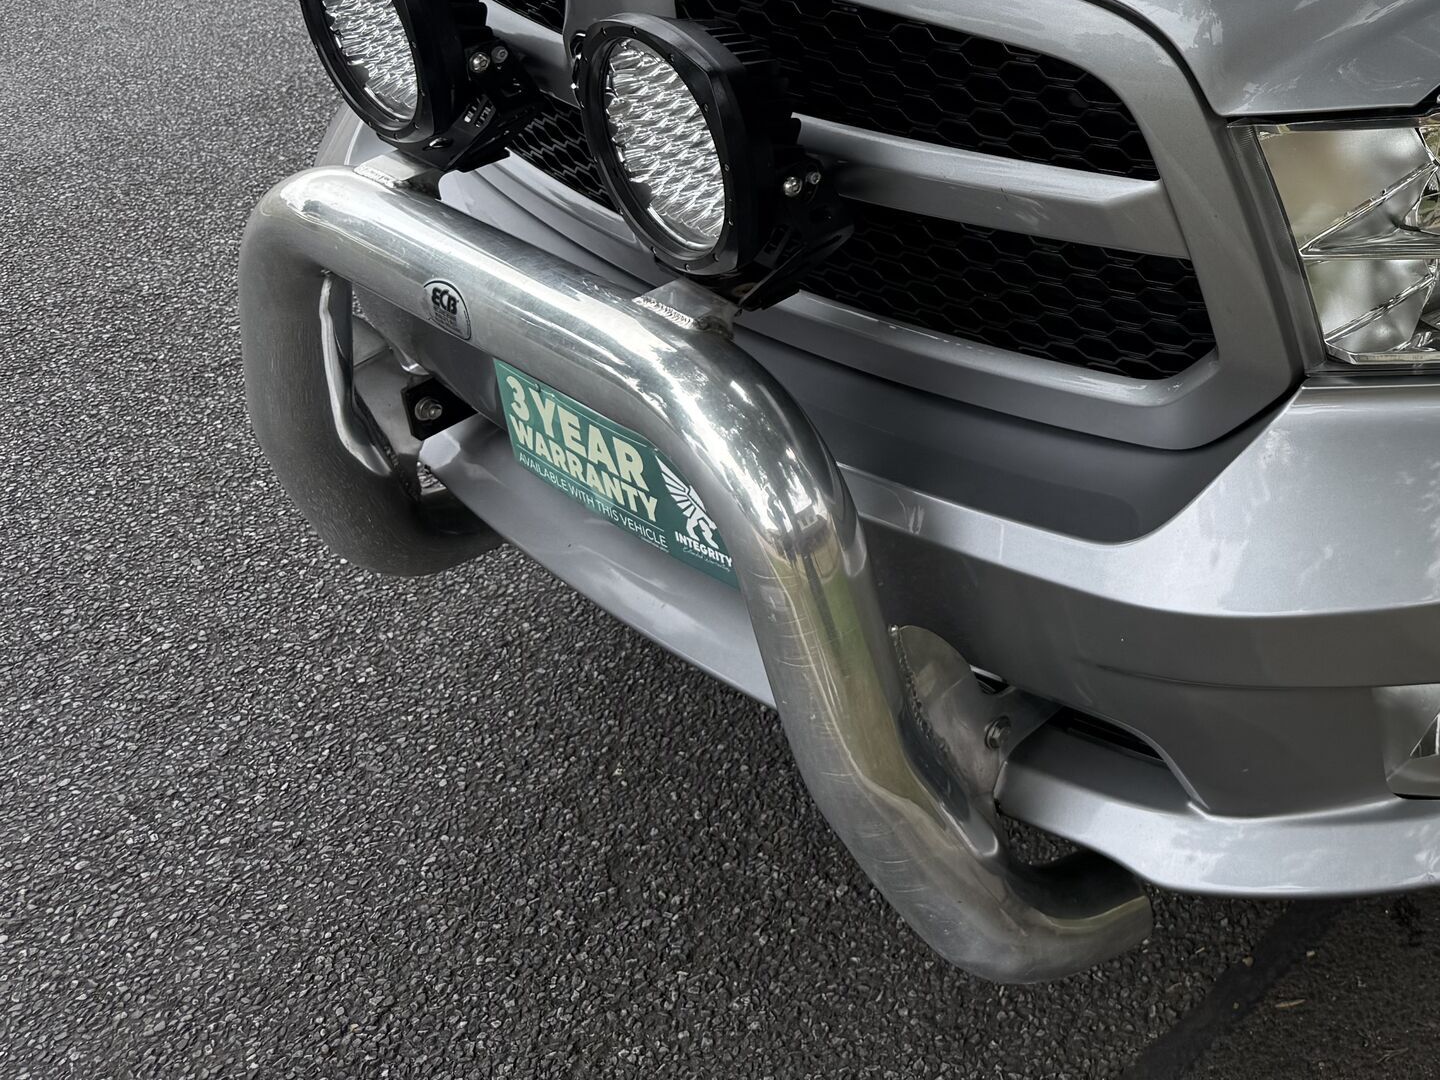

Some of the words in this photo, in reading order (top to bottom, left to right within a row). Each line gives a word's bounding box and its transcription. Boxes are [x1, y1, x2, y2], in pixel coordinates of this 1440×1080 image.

[431, 286, 458, 315] ECB
[506, 375, 530, 422] 3
[528, 386, 650, 492] YEAR
[509, 413, 658, 523] WARRANTY
[519, 452, 569, 492] AVAILABLE
[567, 483, 595, 508] WITH
[596, 500, 620, 522] THIS
[619, 513, 669, 549] VEHICLE
[674, 530, 733, 568] INTEGRITY
